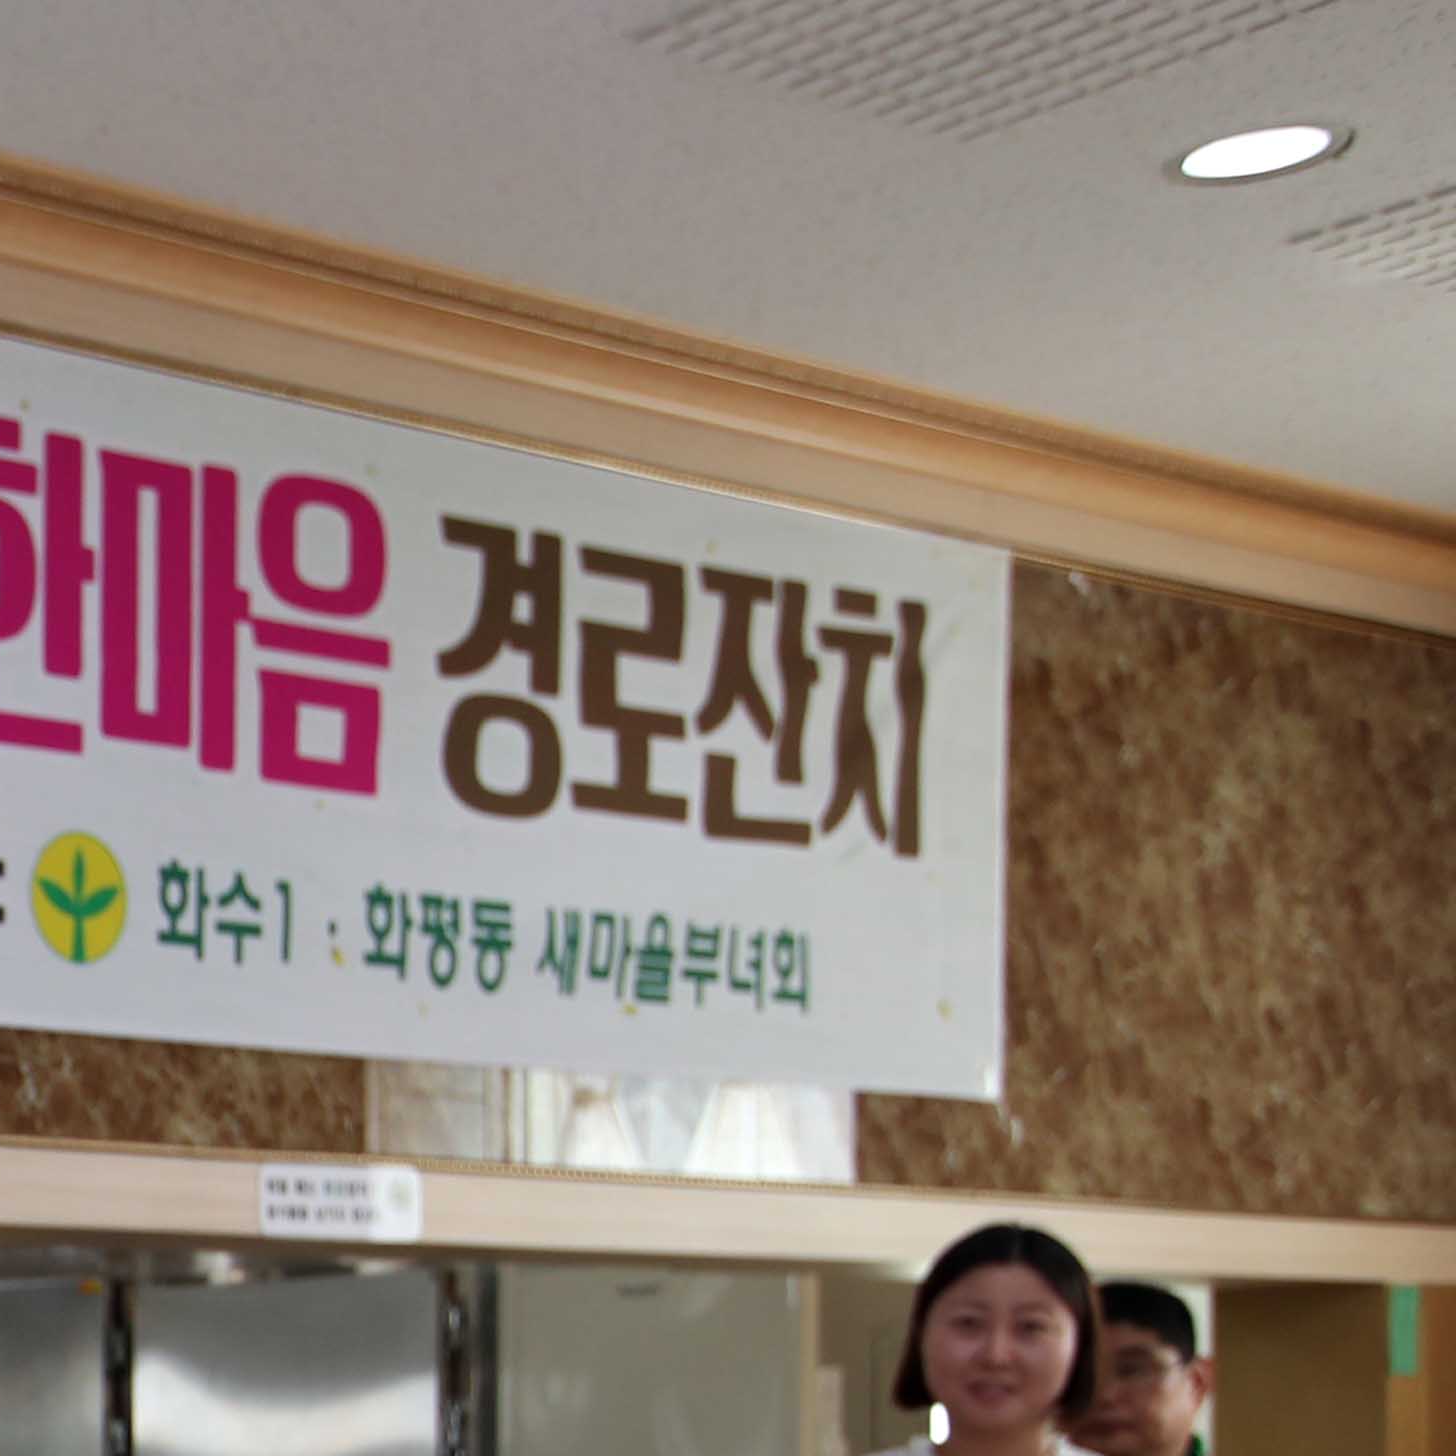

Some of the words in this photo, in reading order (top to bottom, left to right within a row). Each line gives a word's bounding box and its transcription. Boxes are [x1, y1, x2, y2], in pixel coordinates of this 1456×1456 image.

[436, 513, 929, 859] 경로잔치
[156, 859, 292, 965] 화수1
[362, 883, 514, 994] 화평동
[535, 908, 810, 1012] 새마을부녀회
